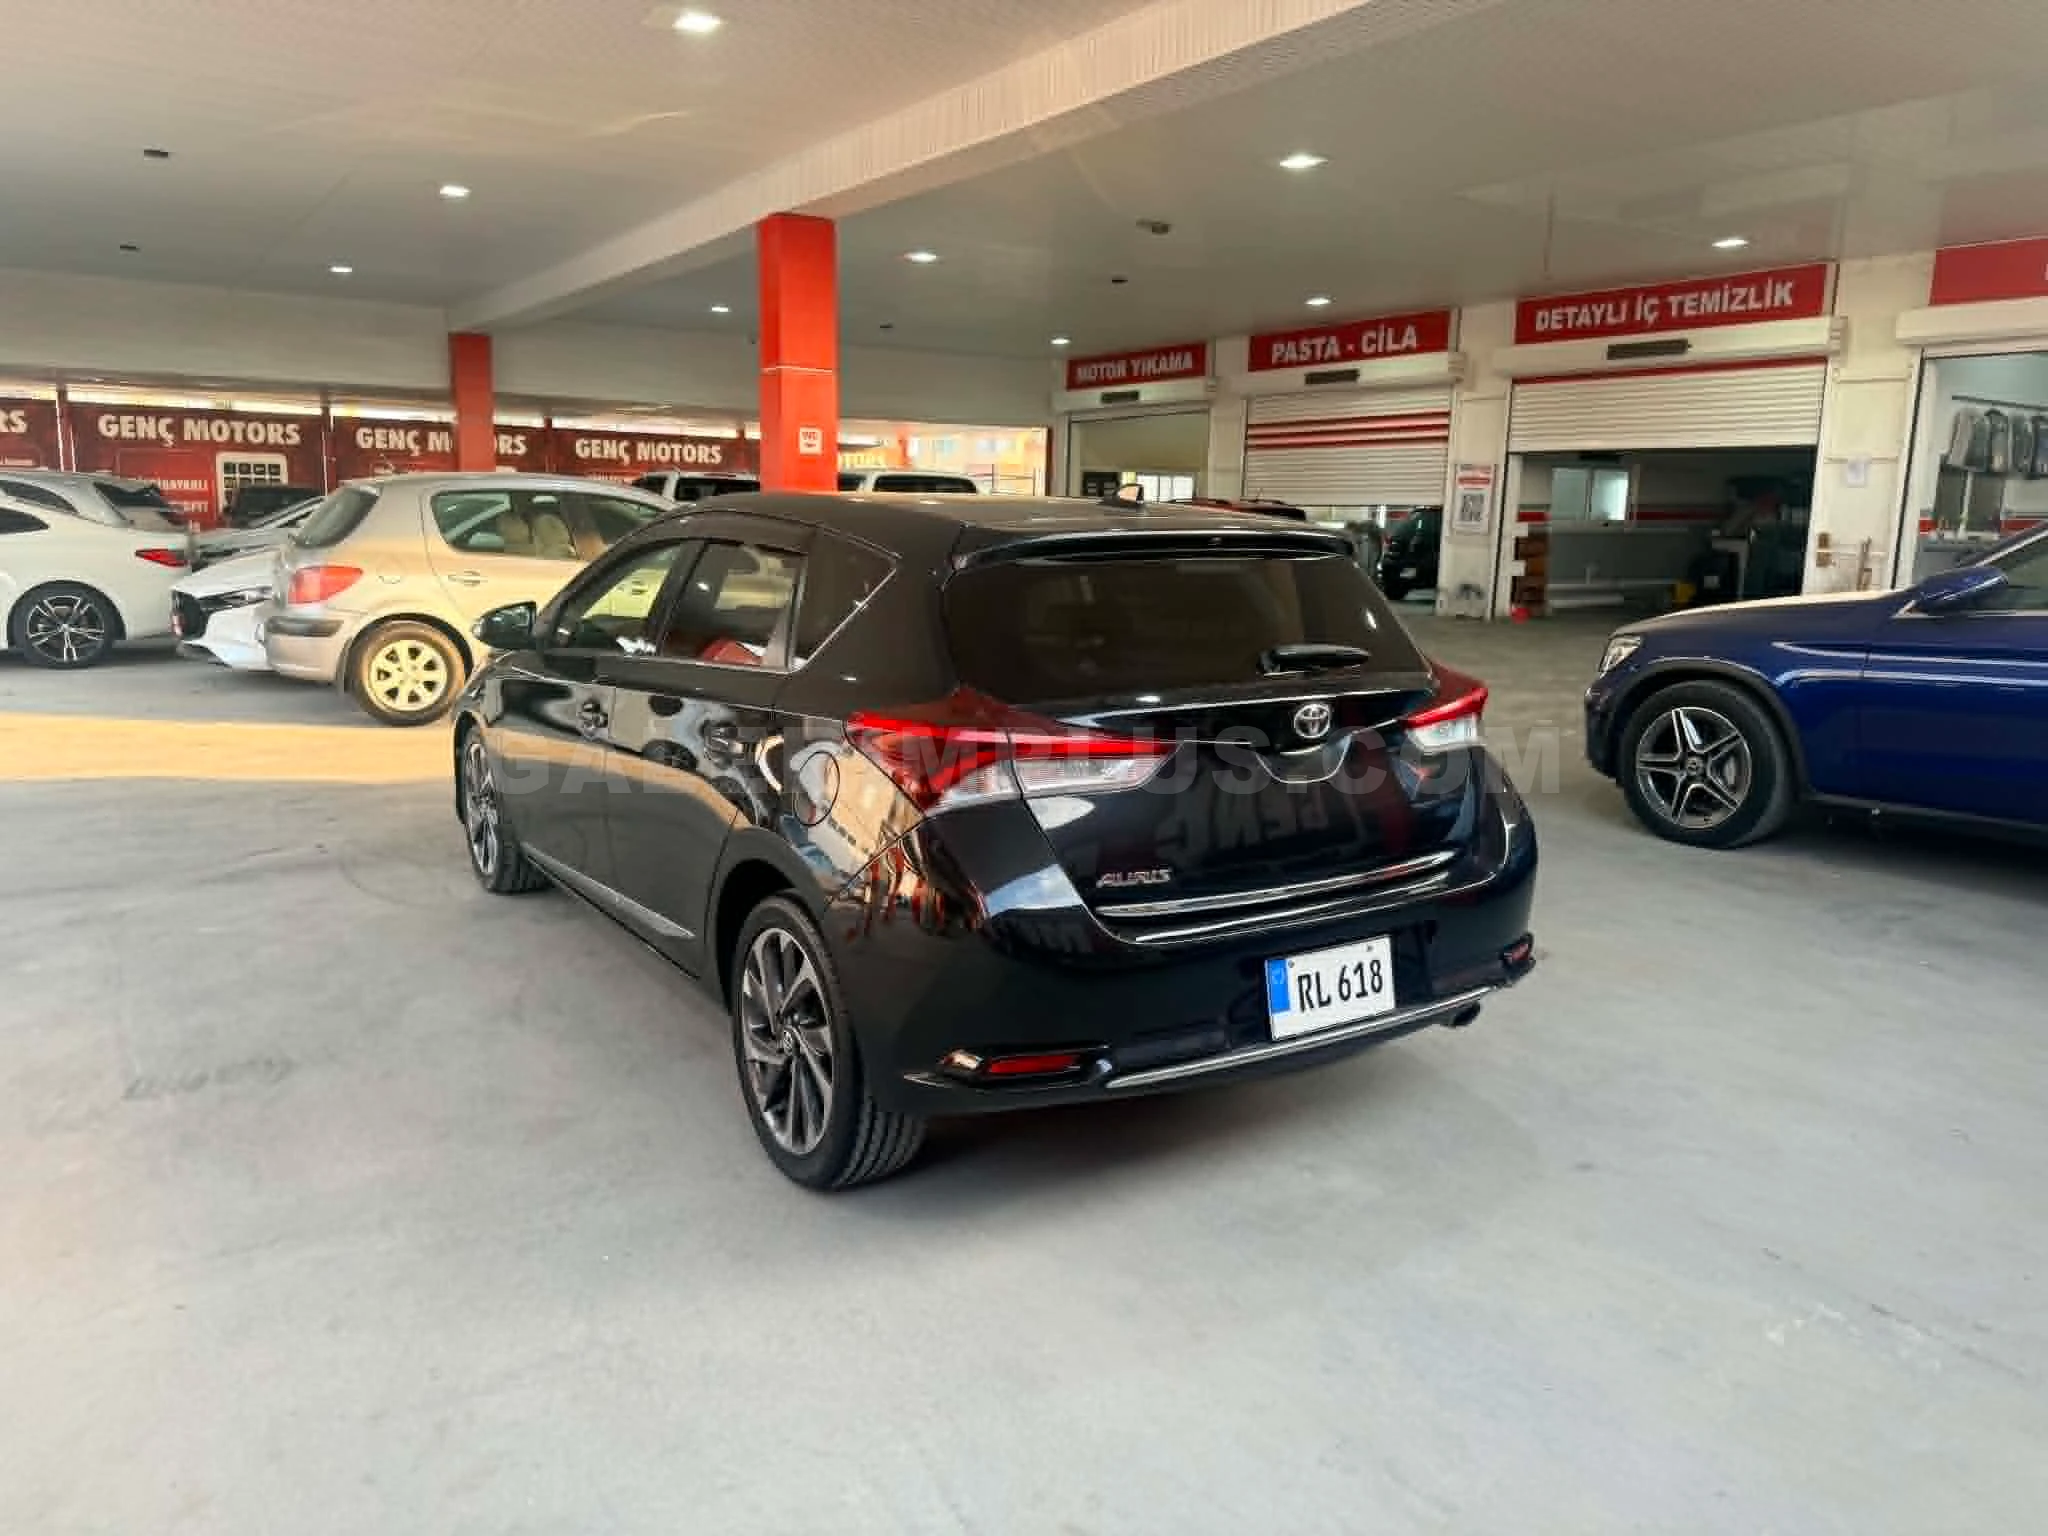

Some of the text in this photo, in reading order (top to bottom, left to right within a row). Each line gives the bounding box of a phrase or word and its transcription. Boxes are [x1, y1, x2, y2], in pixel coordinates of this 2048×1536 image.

[1535, 277, 1794, 332] DETAYLI İÇ TEMİZLİK
[1271, 335, 1341, 365] PASTA
[1361, 323, 1418, 353] CİLA
[1076, 359, 1127, 383] MOTOR
[98, 413, 301, 447] GENÇ MOTORS
[355, 426, 420, 456] GENÇ
[573, 438, 723, 466] GENÇ MOTORS
[1297, 959, 1383, 1013] RL 618
